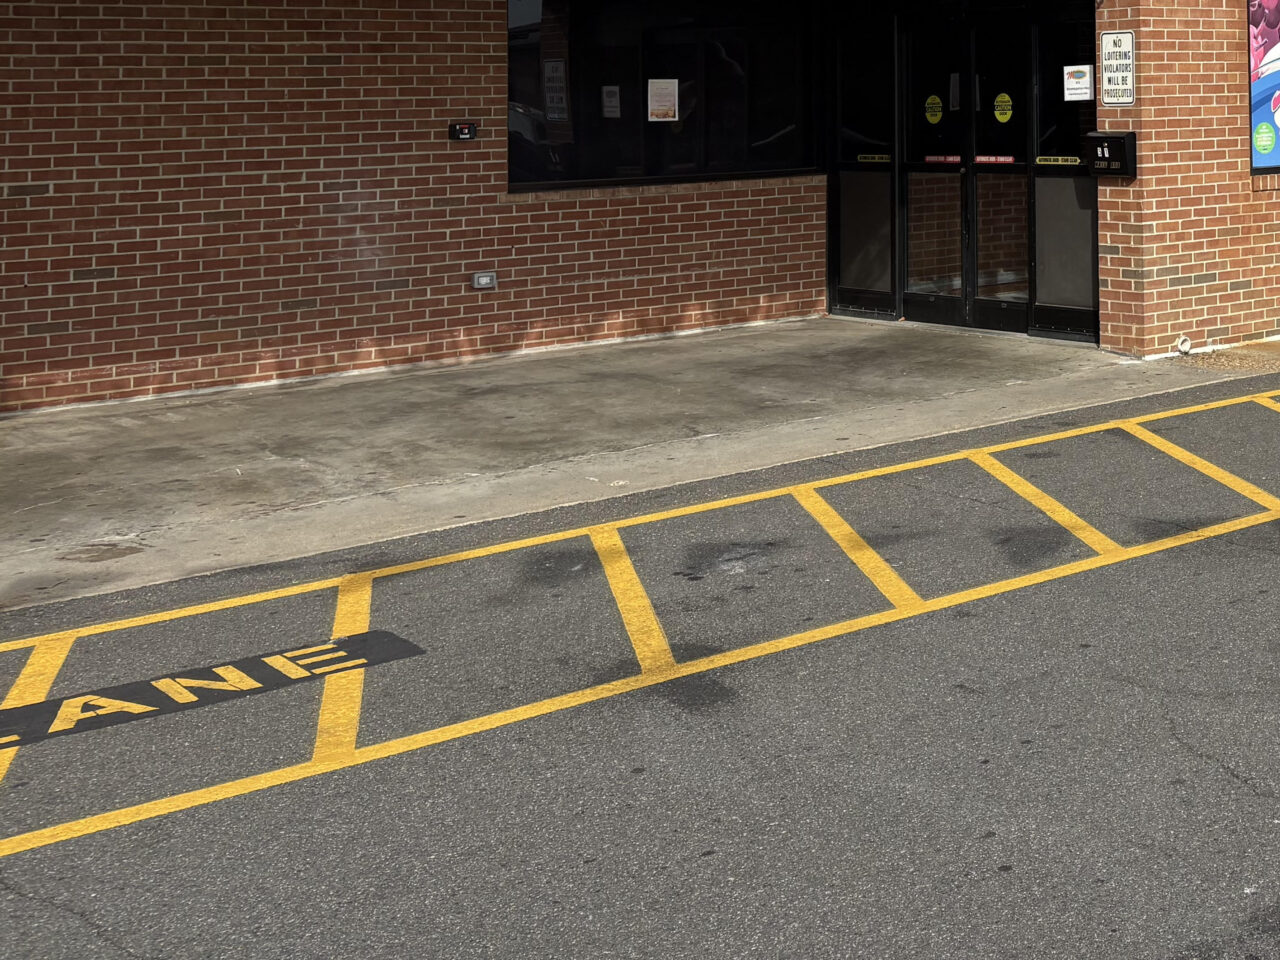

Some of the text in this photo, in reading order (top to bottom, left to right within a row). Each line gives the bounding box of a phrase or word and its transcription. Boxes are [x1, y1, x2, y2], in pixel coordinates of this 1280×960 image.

[1112, 38, 1122, 48] NO
[1104, 50, 1131, 61] LOITERING
[1104, 63, 1132, 73] VIOLATORS
[1107, 75, 1128, 86] WILL BE
[1104, 88, 1132, 98] PROSECUTED
[0, 643, 368, 746] ANE
